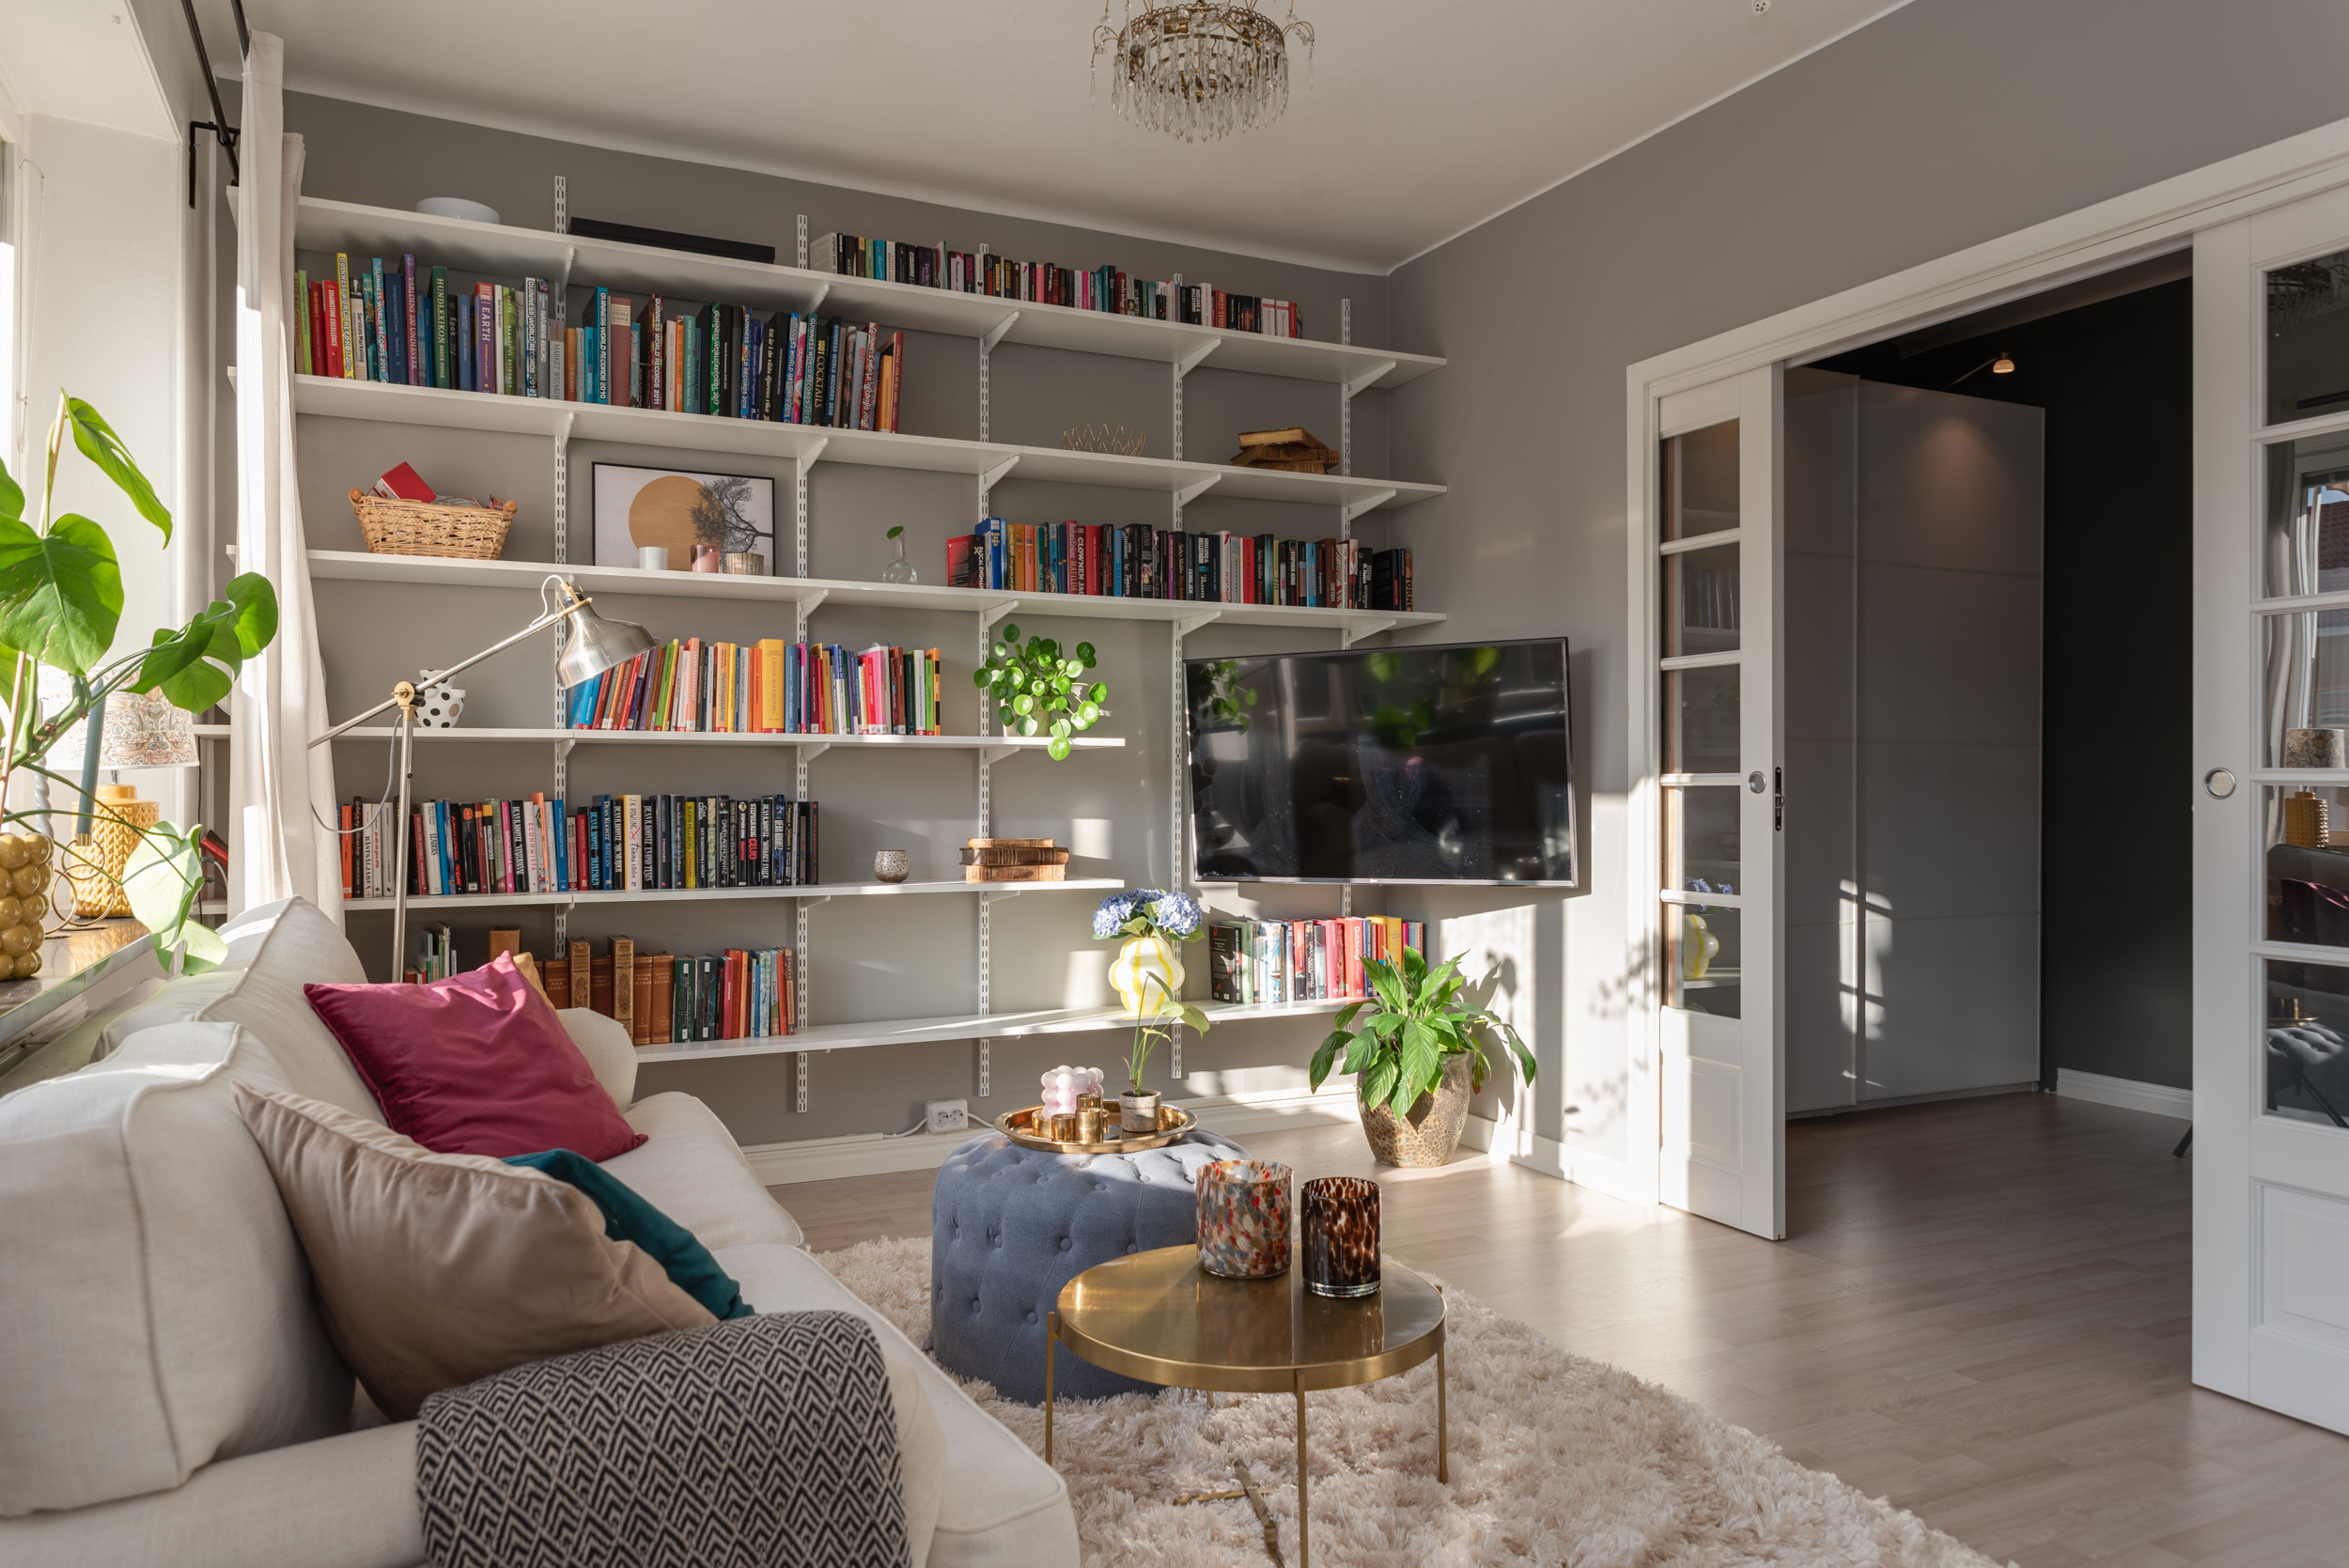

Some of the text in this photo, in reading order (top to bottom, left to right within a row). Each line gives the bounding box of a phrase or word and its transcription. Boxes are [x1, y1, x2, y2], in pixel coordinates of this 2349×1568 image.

[374, 267, 382, 300] GUINNESS
[437, 278, 445, 344] HUNDLEXIKON
[868, 327, 877, 359] GUINNESS
[815, 356, 824, 408] COCKTAILS
[853, 363, 864, 412] COCKTAILS
[429, 833, 438, 855] LEADERS
[749, 838, 757, 860] CUJO
